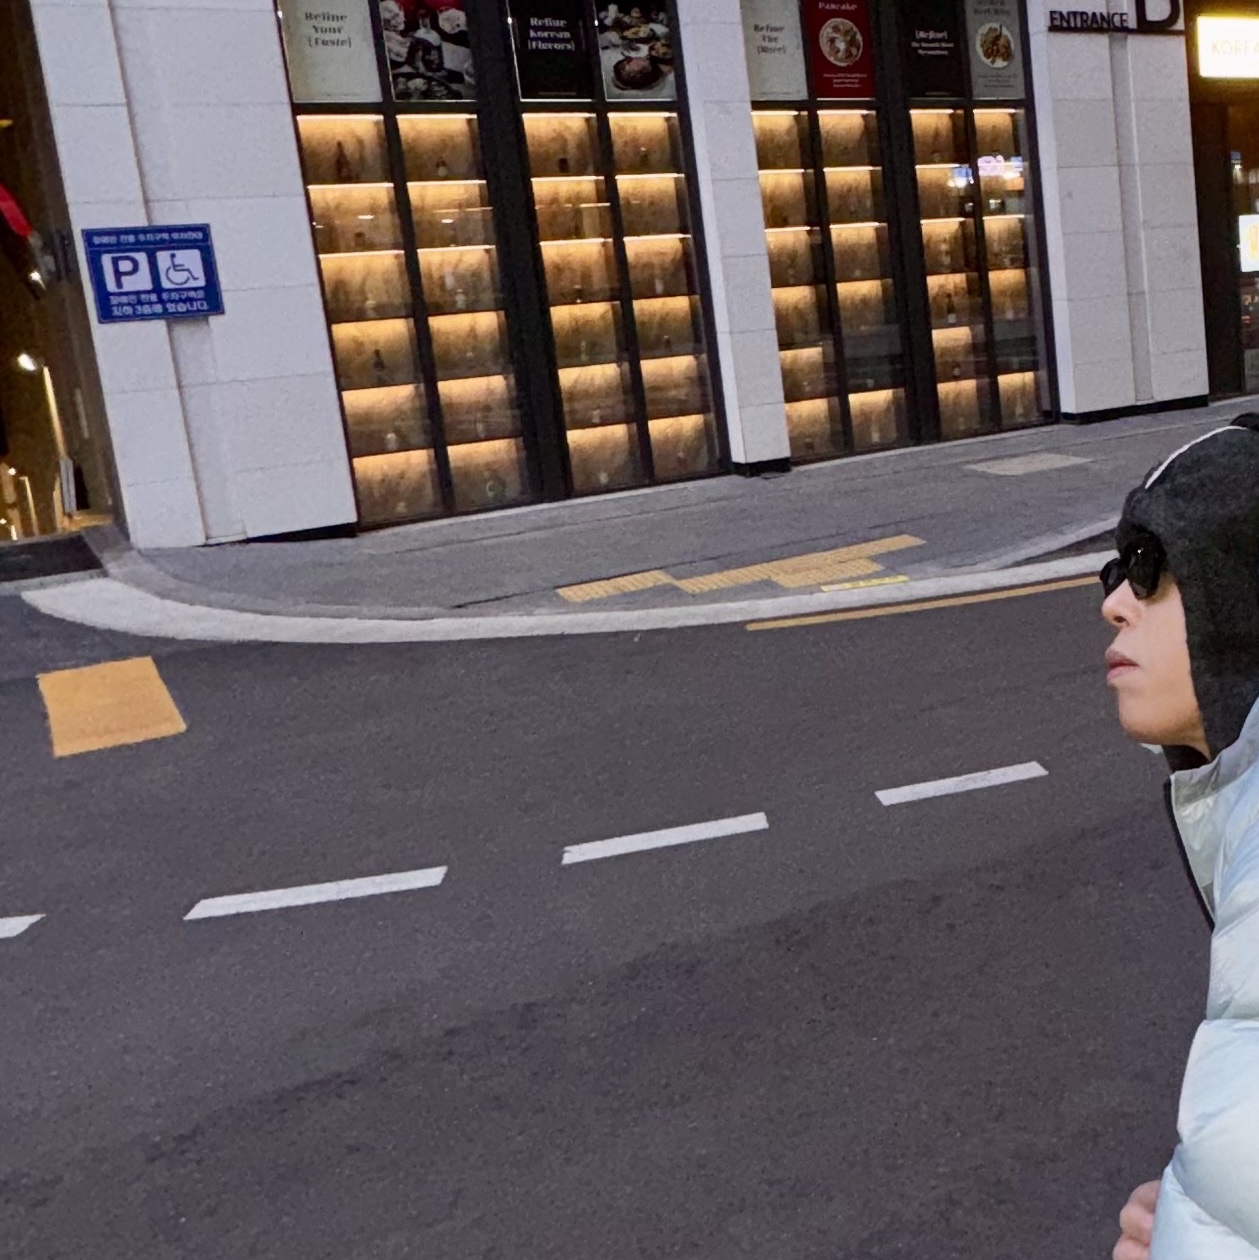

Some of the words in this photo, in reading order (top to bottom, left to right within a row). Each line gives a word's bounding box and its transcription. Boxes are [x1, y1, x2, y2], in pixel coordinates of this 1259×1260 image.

[529, 17, 568, 28] Refine
[1049, 10, 1128, 29] ENTRANCE
[529, 29, 572, 39] Korean
[111, 255, 139, 290] P
